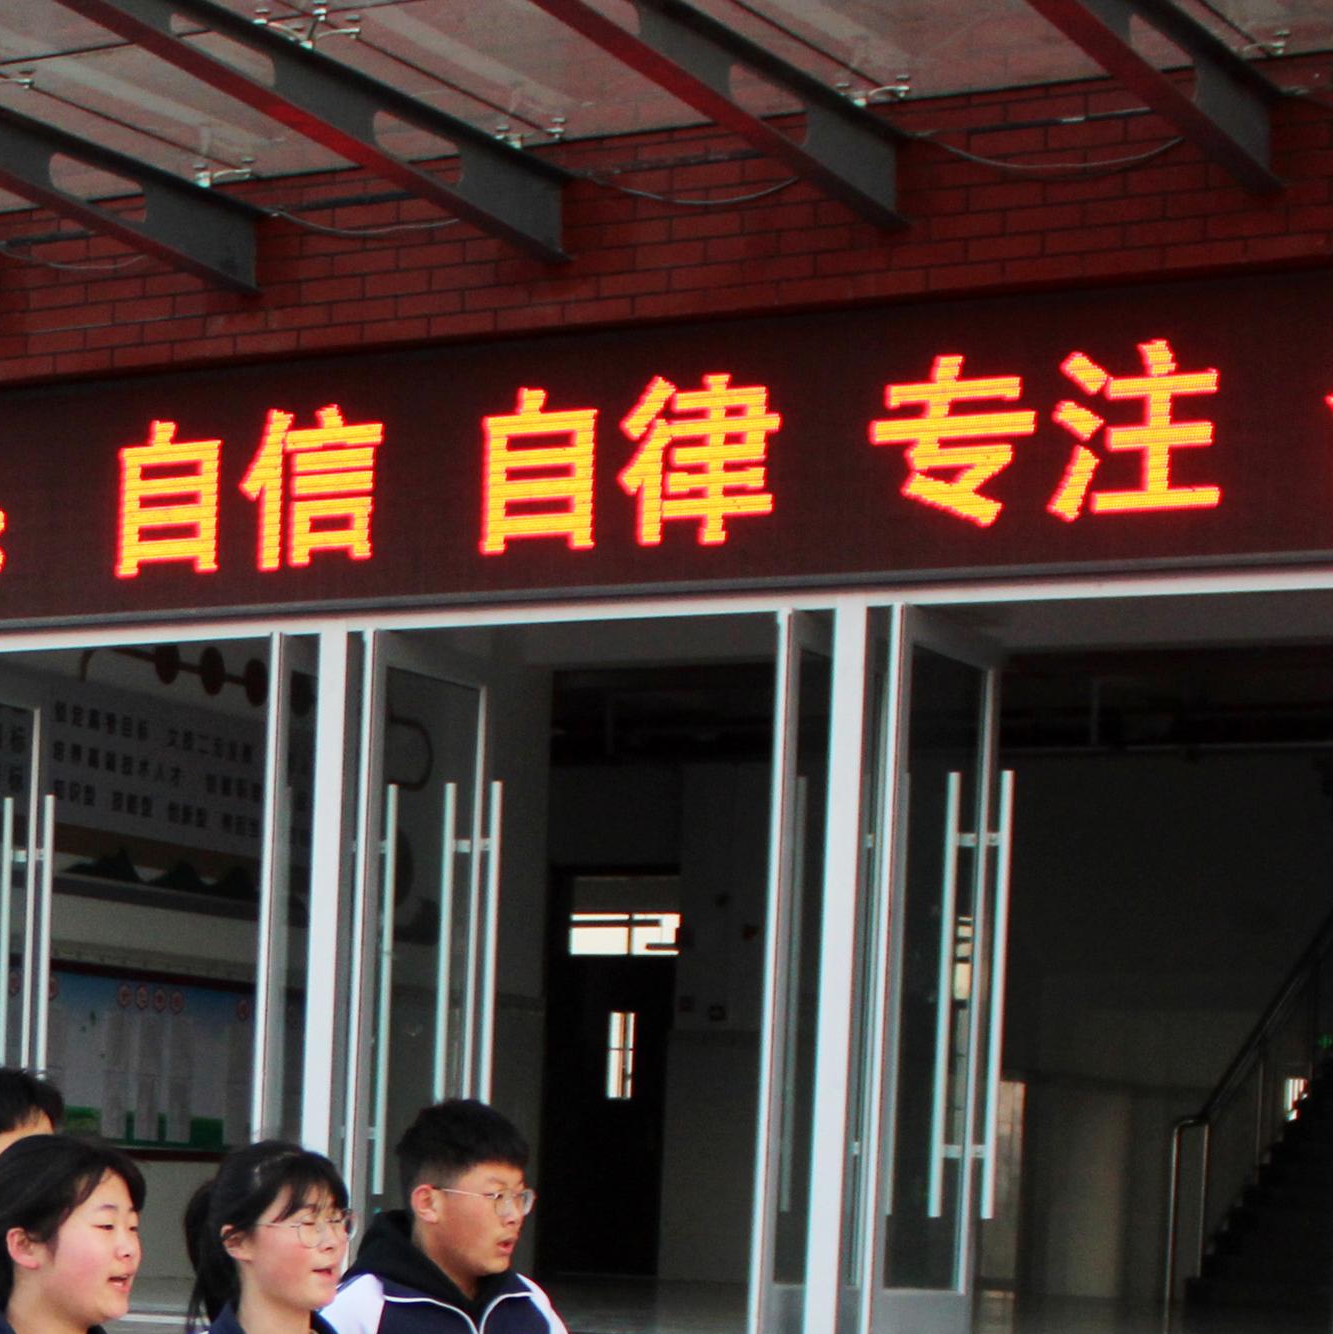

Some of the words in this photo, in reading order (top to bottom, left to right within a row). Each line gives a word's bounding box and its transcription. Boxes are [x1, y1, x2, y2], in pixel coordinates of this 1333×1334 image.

[115, 404, 384, 579] 自信
[479, 373, 782, 556] 自律
[869, 339, 1221, 528] 专注
